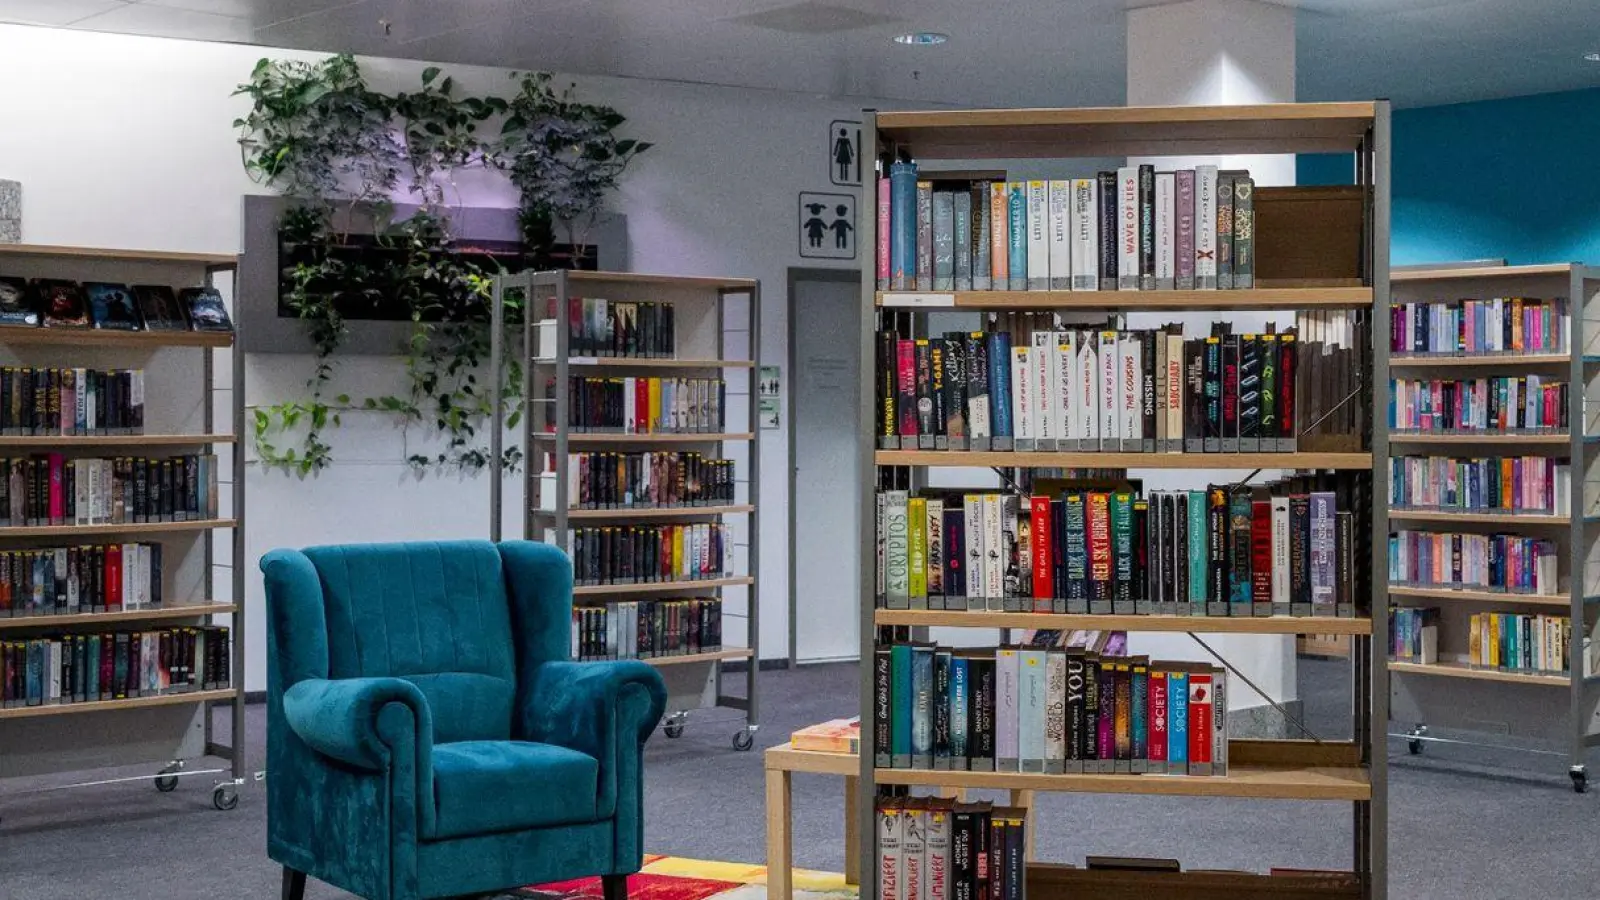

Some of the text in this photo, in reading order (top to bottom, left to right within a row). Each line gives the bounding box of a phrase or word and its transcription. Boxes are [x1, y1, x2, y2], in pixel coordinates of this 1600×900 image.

[1013, 198, 1021, 248] NUMBER 10
[1034, 214, 1042, 241] LITTLE
[1081, 214, 1089, 241] LITTLE
[1126, 178, 1135, 254] WAVE OF LIES
[1142, 202, 1152, 254] AUTONOMY
[932, 348, 943, 390] Y-GAME
[945, 339, 962, 382] Killing
[1125, 355, 1134, 392] COUSINS
[1106, 387, 1112, 395] OF
[1126, 393, 1134, 411] THE
[1144, 375, 1154, 416] MISSING
[1169, 360, 1180, 410] SANCTUARY
[887, 513, 906, 577] CRYPTOS
[928, 515, 939, 538] LEFT
[1067, 531, 1084, 553] BLUE
[1091, 500, 1109, 581] RED SKY BURNING
[1068, 555, 1085, 580] DARK
[1118, 555, 1131, 580] BLACK
[1068, 659, 1083, 702] YOU
[878, 703, 888, 719] Good
[1053, 701, 1063, 742] WORLD
[1155, 685, 1165, 732] SOCIETY
[1176, 686, 1186, 733] SOCIETY
[882, 854, 896, 900] FIZIERT
[961, 857, 968, 870] WO
